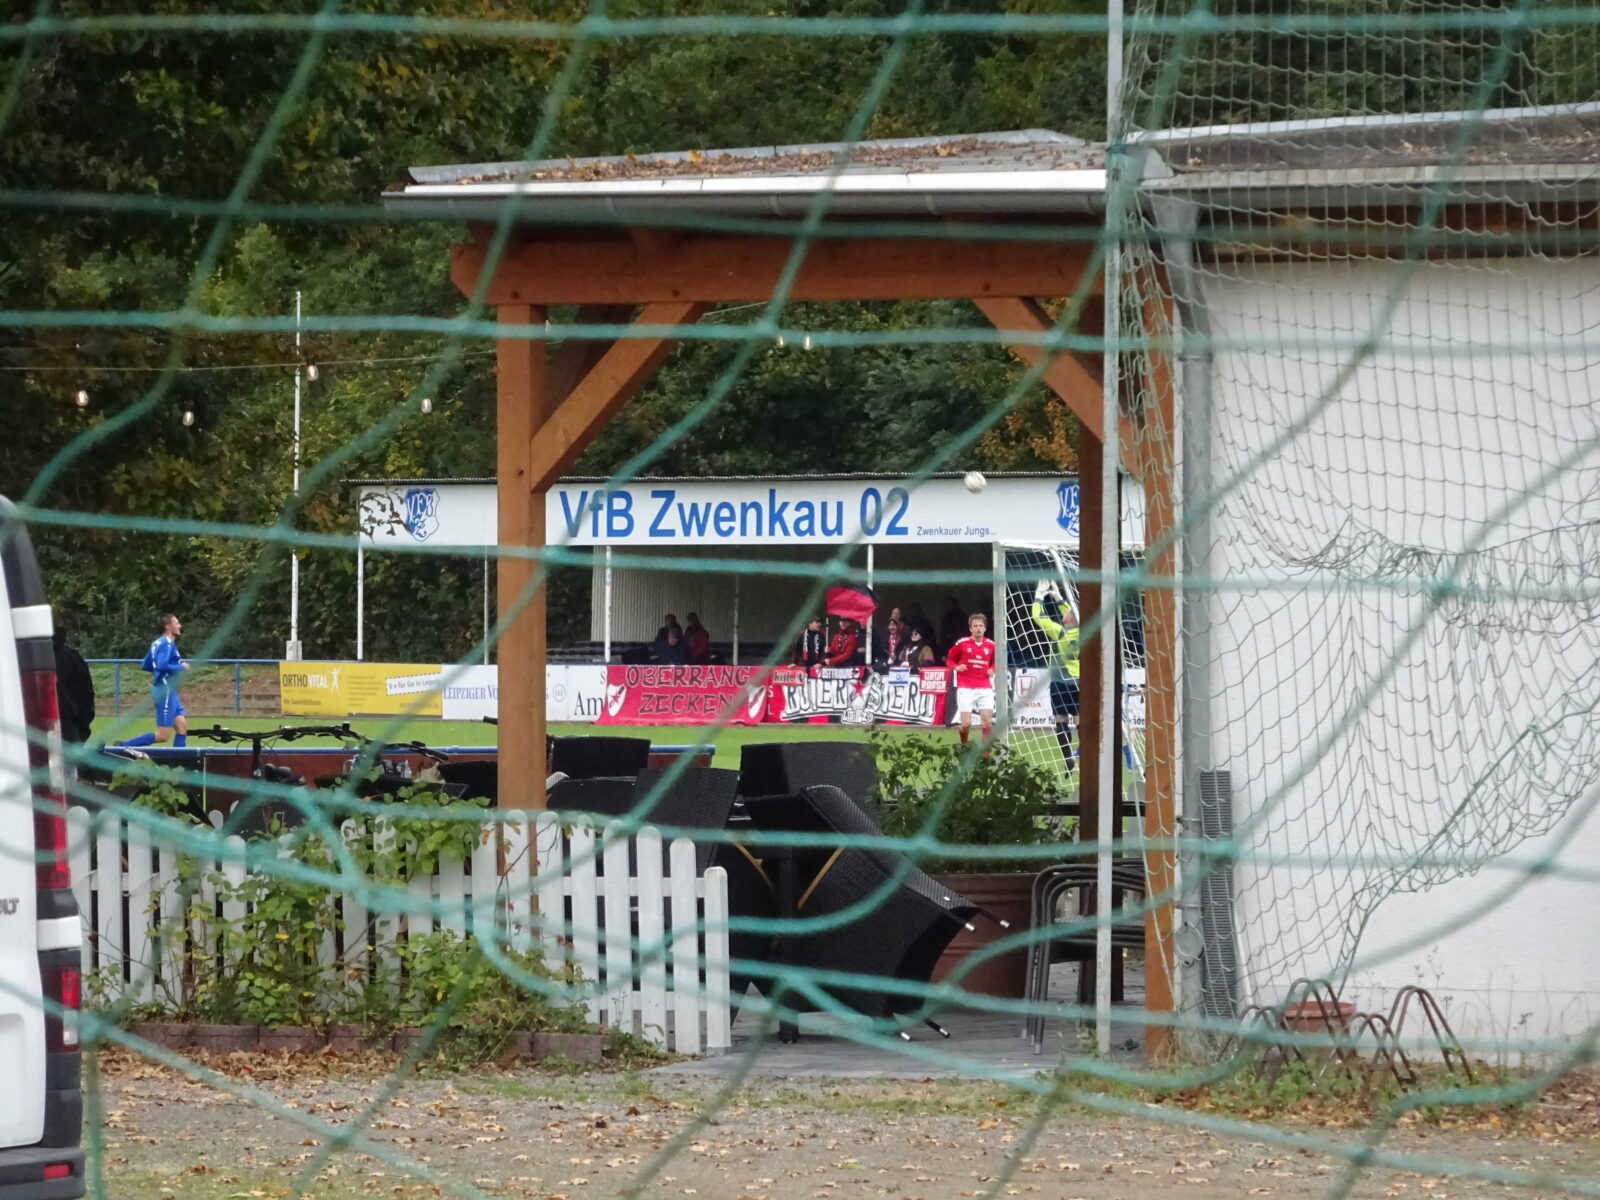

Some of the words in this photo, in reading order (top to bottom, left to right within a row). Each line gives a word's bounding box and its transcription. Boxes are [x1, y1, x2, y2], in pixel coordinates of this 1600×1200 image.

[559, 490, 634, 537] VfB
[648, 488, 843, 537] Zwenkau
[860, 487, 910, 537] 02
[917, 526, 962, 536] Zwenkauer
[626, 666, 752, 687] OBERRANG
[443, 687, 487, 700] LEIPZIGER
[640, 692, 733, 715] ZECKEN
[1021, 715, 1046, 726] Partner
